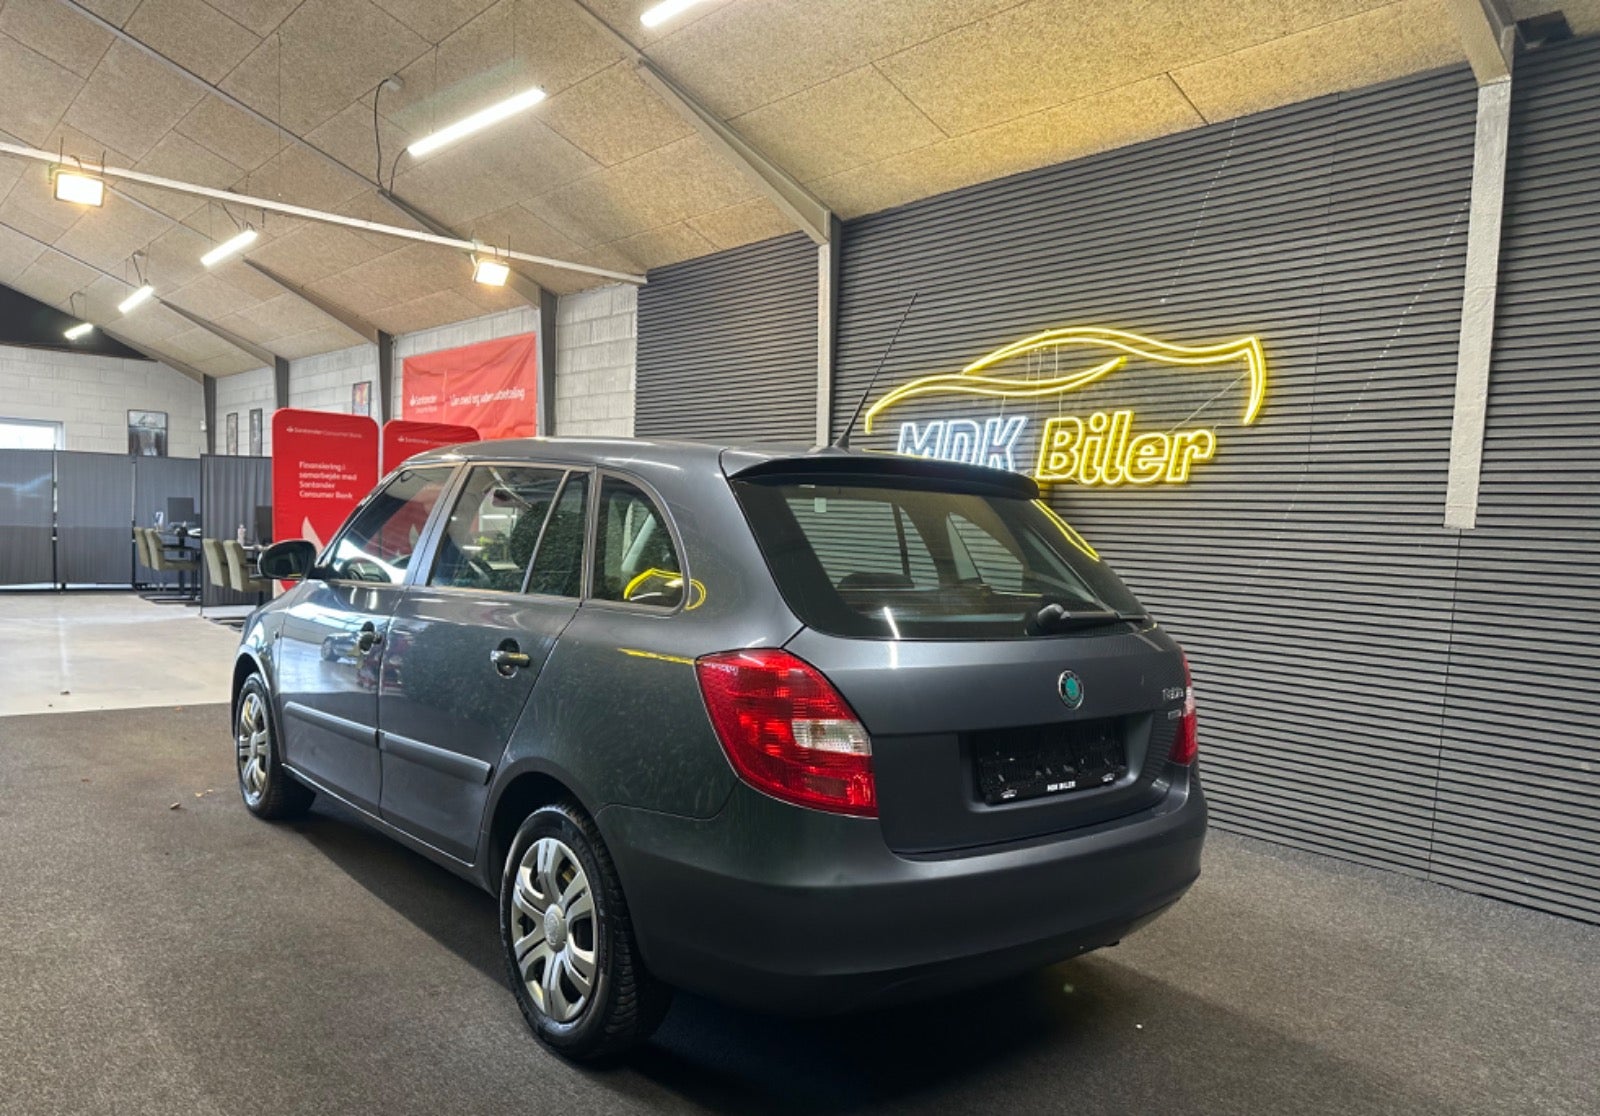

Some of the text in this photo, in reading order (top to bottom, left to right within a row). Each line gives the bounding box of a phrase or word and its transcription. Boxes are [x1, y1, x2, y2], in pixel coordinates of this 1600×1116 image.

[897, 409, 1217, 486] MDK Biler
[299, 460, 341, 472] Finansiering
[299, 471, 358, 481] samarbejde med
[299, 480, 335, 489] Santander
[299, 489, 353, 499] Consumer Bank
